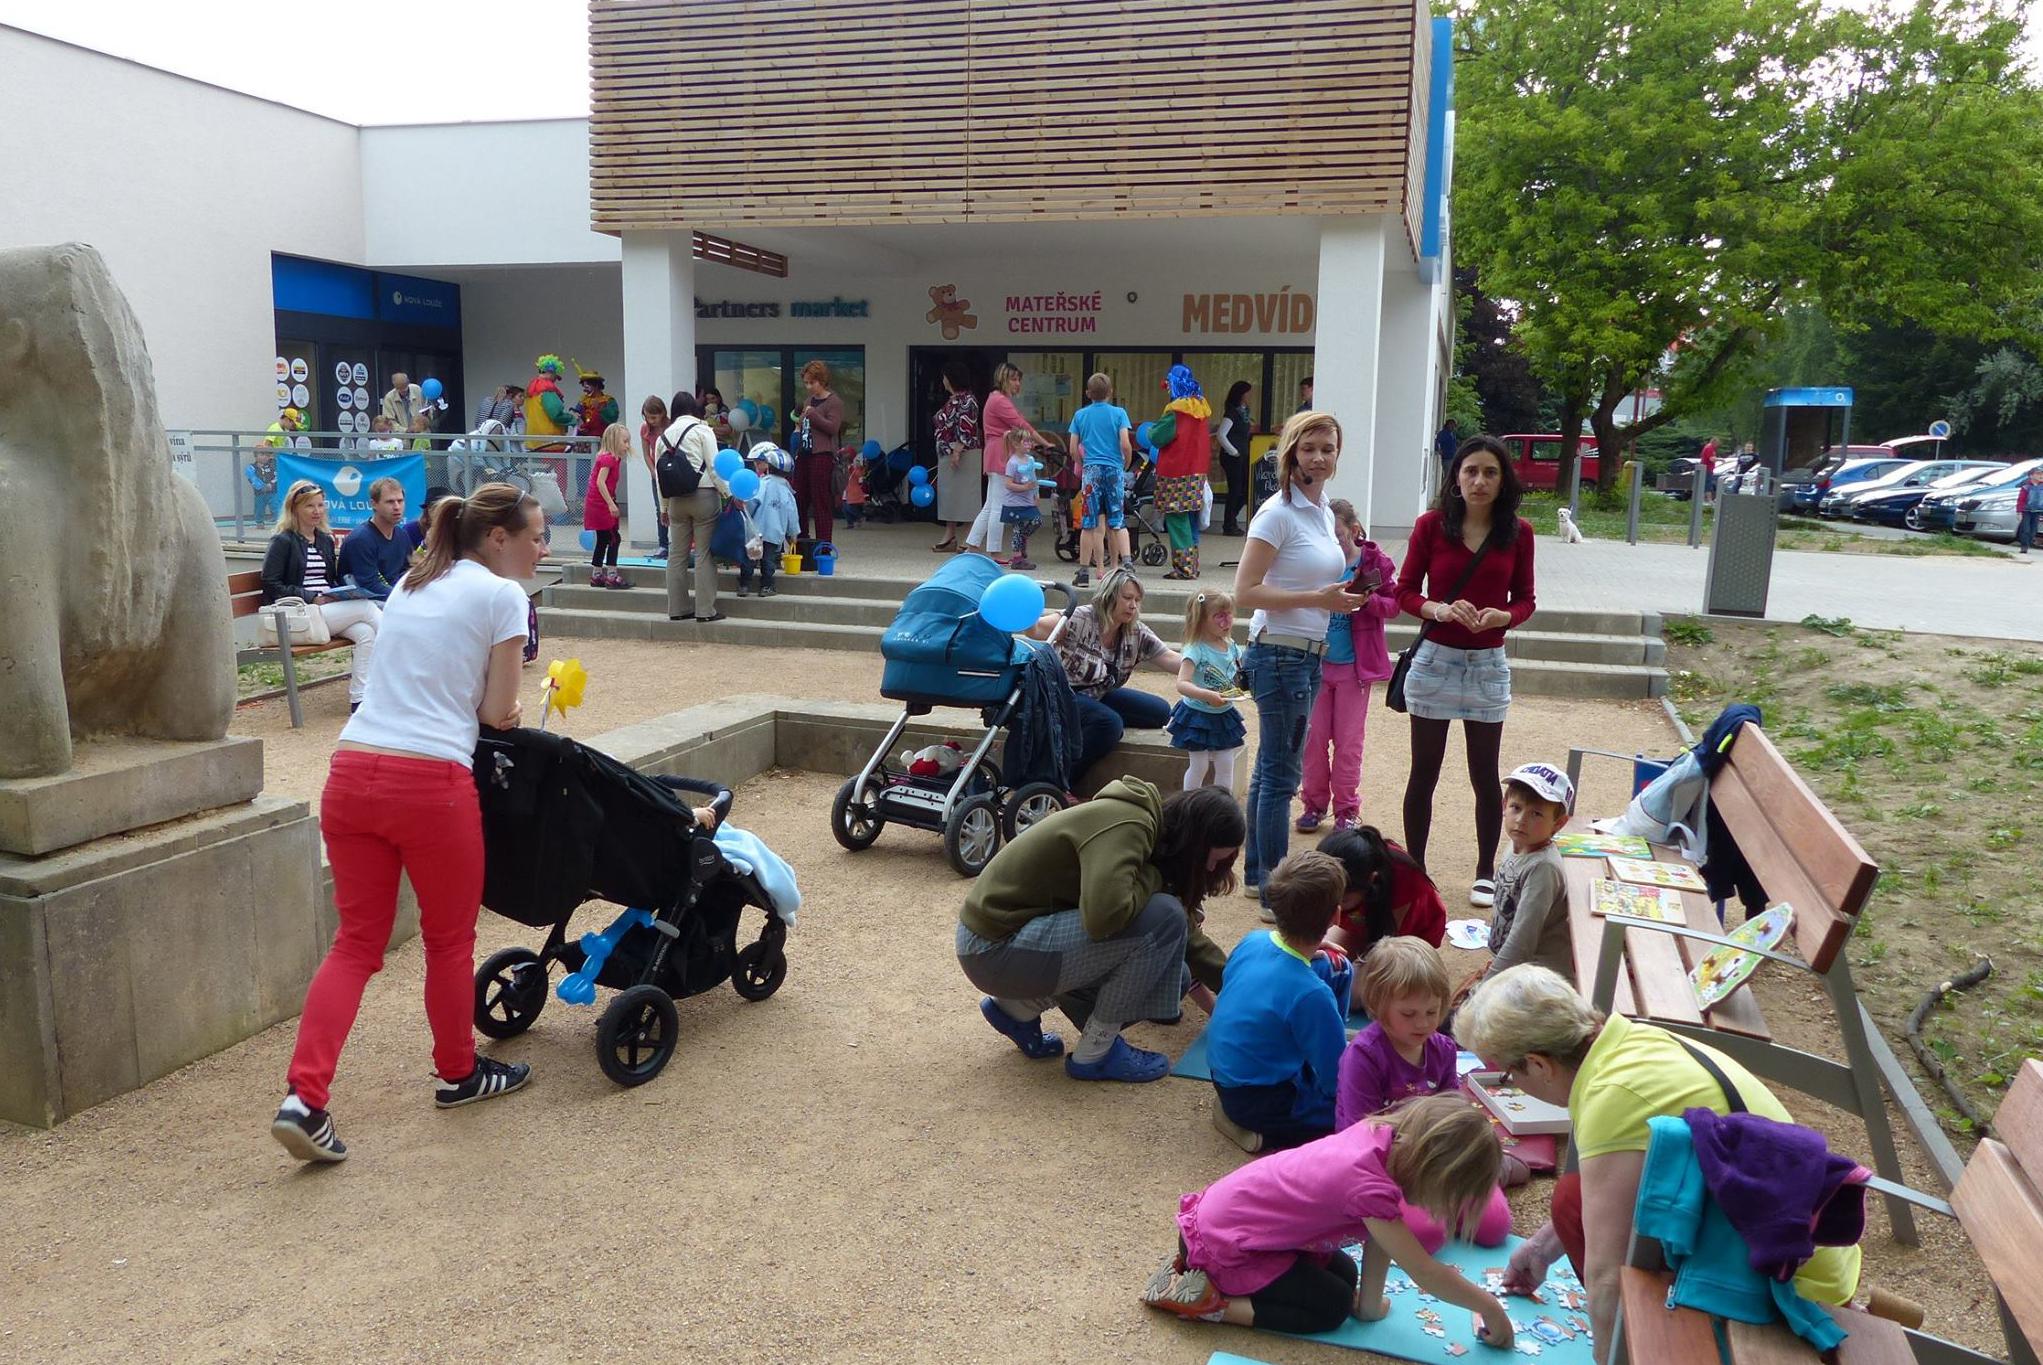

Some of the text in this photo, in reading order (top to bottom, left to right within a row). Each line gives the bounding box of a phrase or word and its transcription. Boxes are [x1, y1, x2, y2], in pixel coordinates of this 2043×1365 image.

[790, 296, 869, 318] market
[1005, 291, 1102, 312] MATEŘSKÉ
[1008, 316, 1096, 333] CENTRUM
